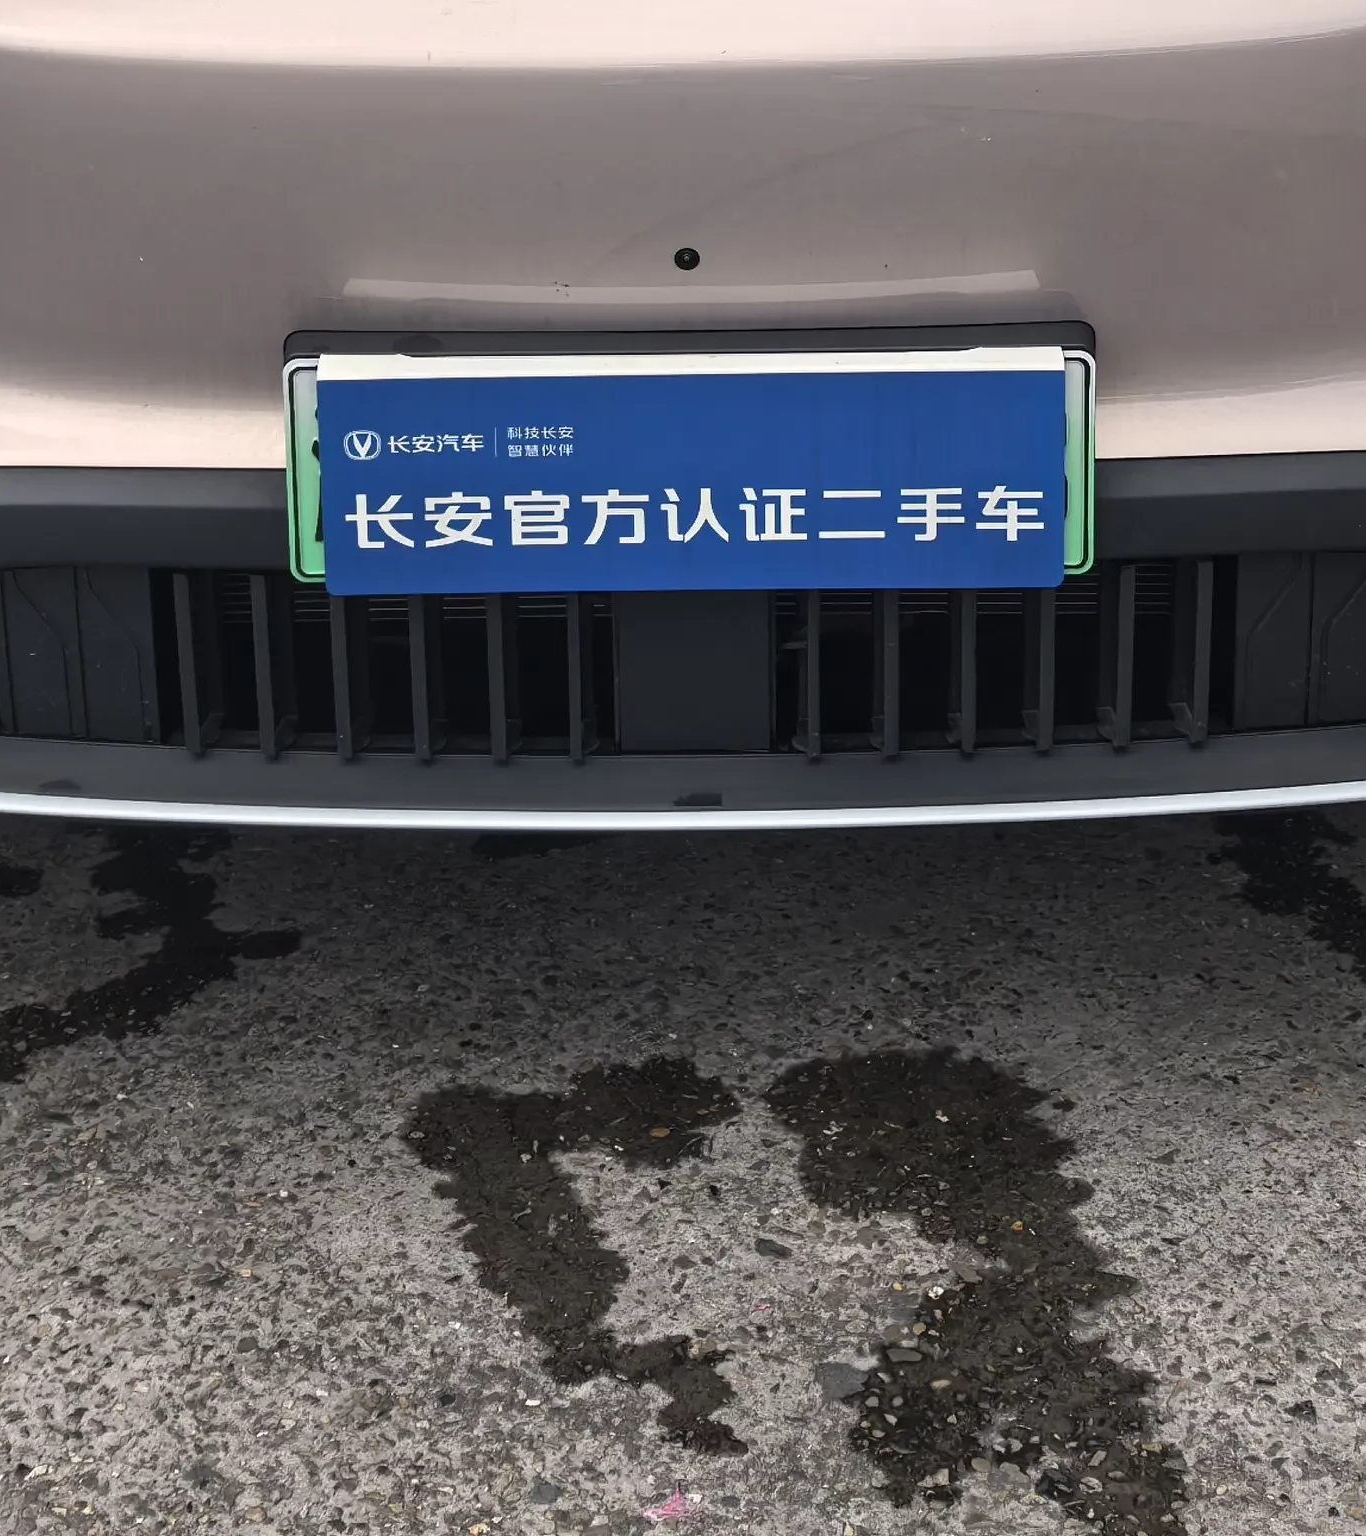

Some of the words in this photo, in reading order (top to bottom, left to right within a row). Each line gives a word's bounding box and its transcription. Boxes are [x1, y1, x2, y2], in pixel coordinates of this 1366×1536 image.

[507, 426, 574, 440] 科技长安
[387, 433, 484, 454] 长安汽车
[507, 443, 574, 457] 智慧伙伴
[344, 485, 1045, 549] 长安官方认证二手车
